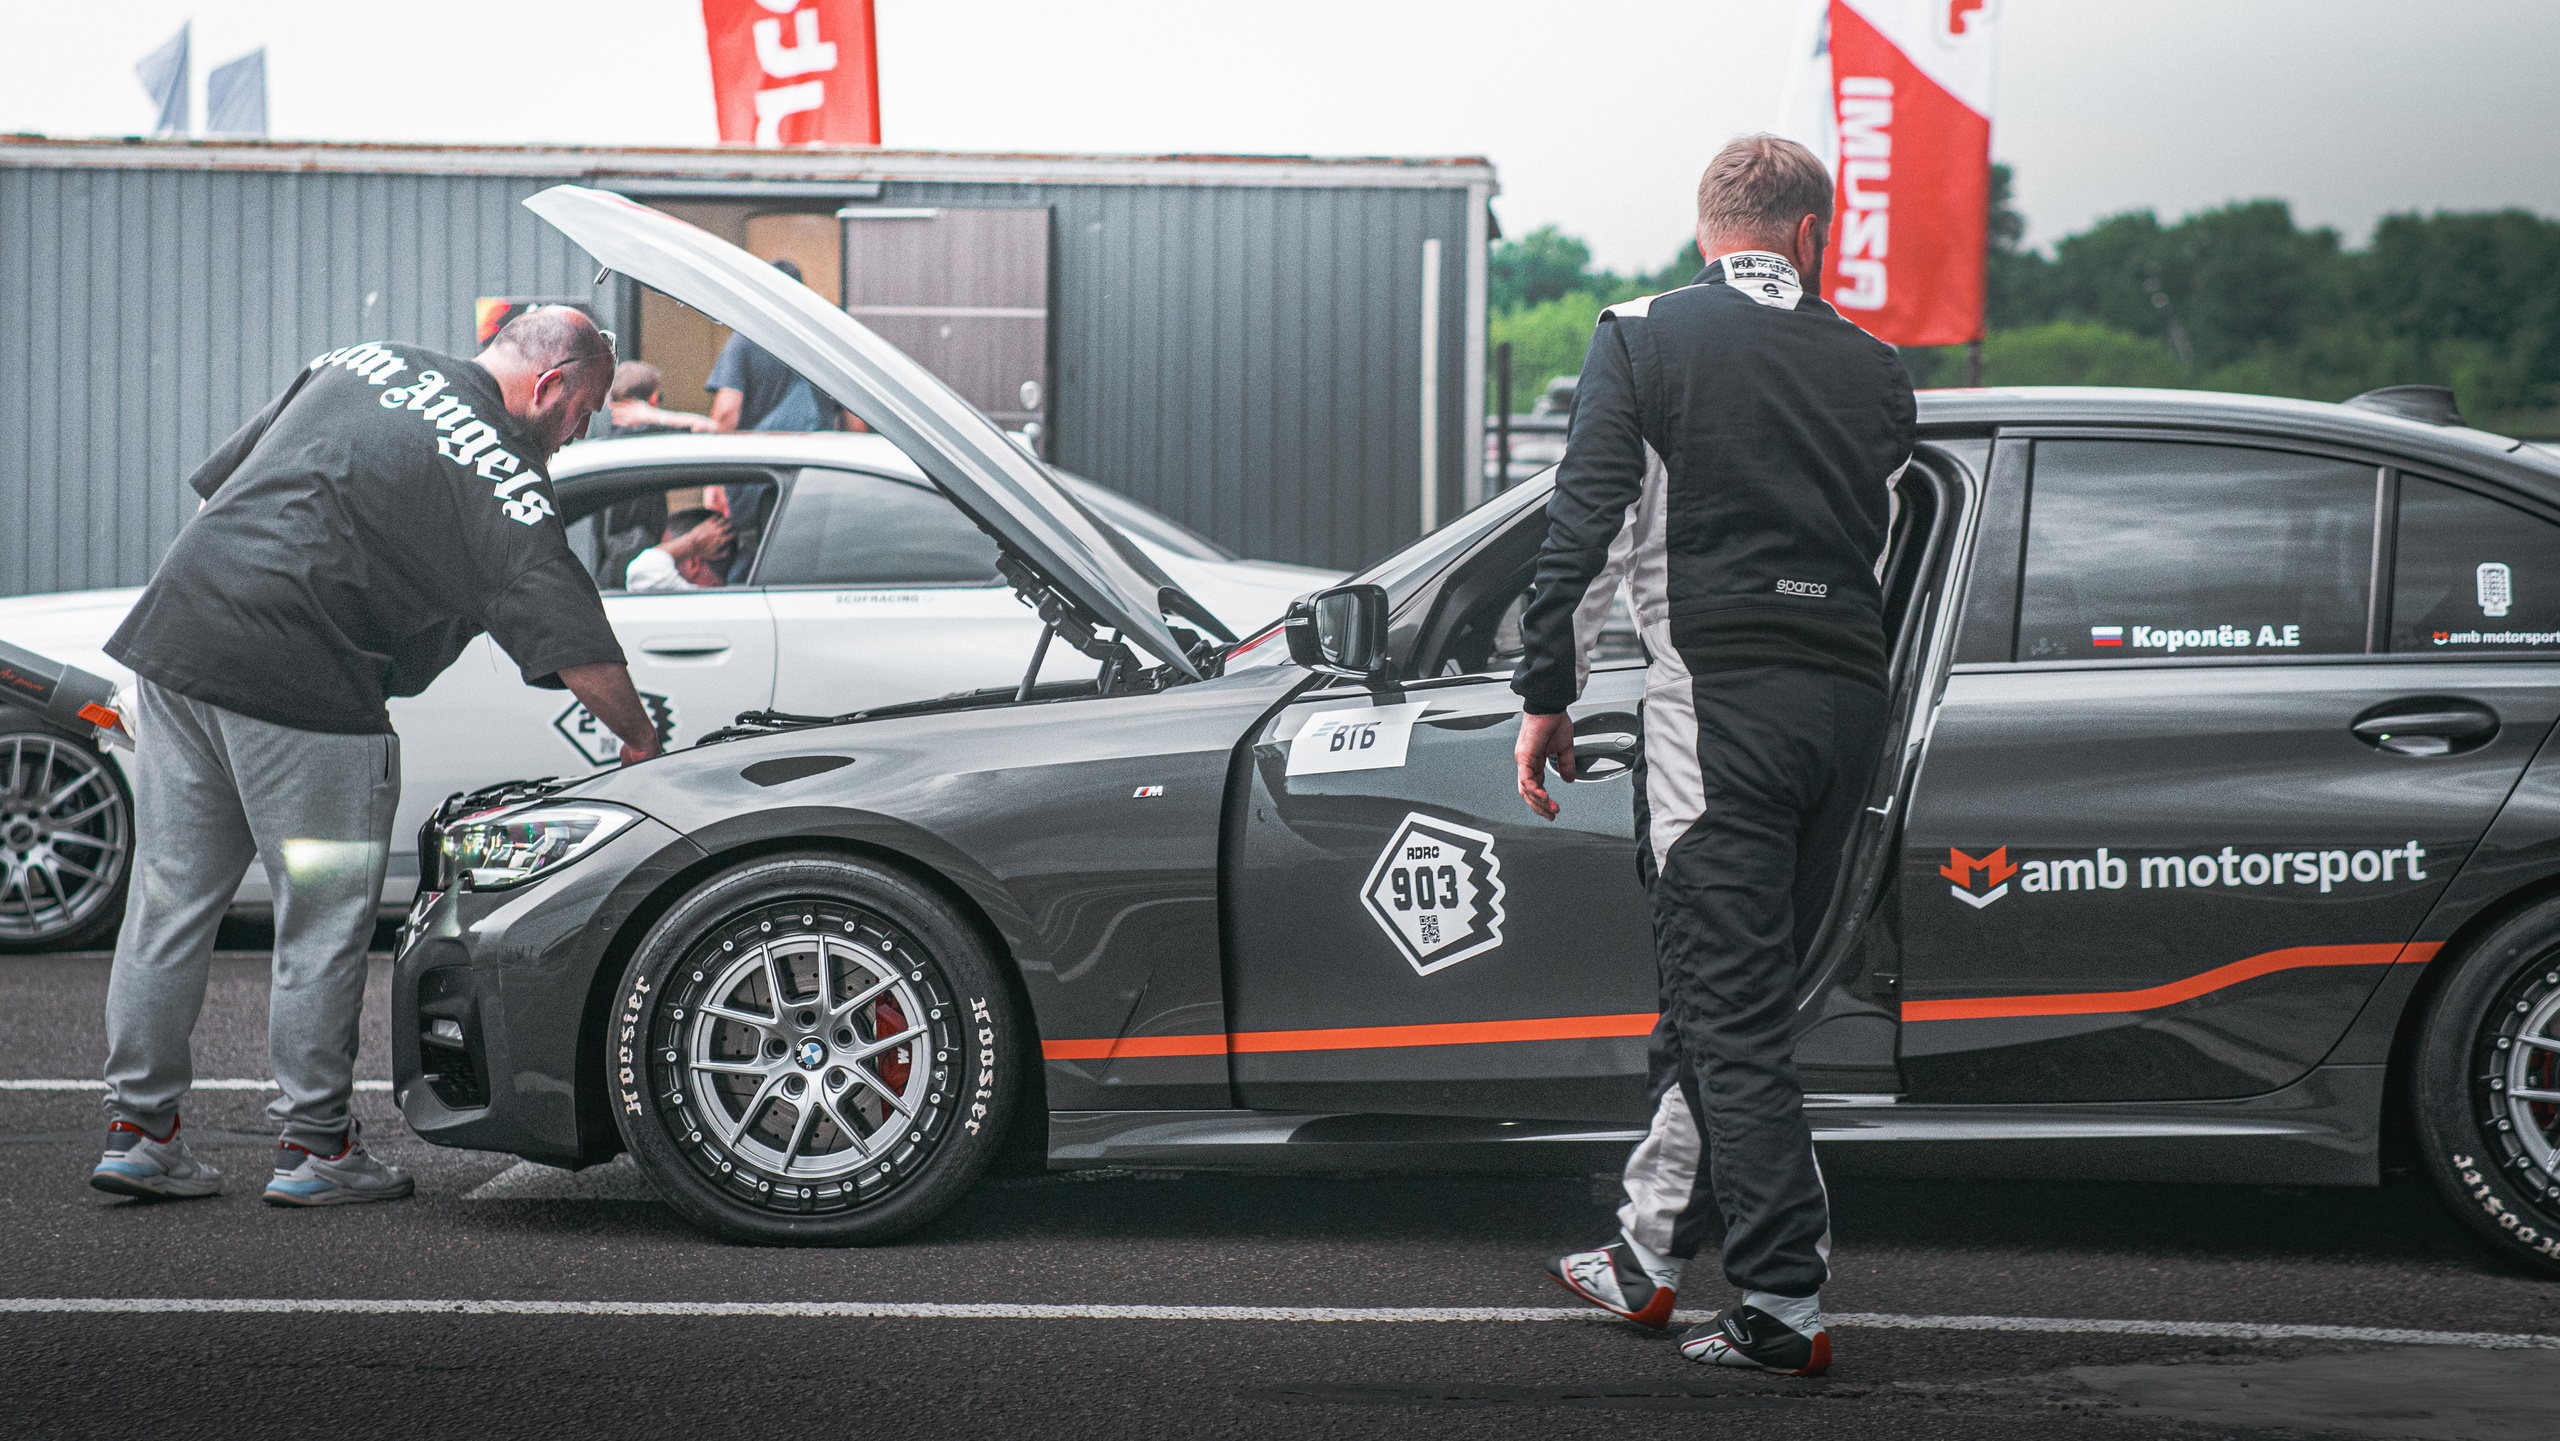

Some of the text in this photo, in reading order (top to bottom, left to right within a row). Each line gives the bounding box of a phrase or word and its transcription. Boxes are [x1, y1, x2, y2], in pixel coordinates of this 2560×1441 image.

[380, 369, 555, 526] Angels
[1776, 578, 1828, 597] sparco
[2132, 625, 2251, 653] Королёв
[2450, 630, 2560, 646] amb motorsport
[1329, 721, 1382, 752] ВТБ
[1406, 846, 1440, 860] RDRC
[2021, 840, 2428, 893] amb motorsport
[1391, 865, 1459, 911] 903
[618, 975, 650, 1116] Hoosier
[954, 997, 995, 1136] Hoosier
[2453, 1154, 2560, 1260] Hoosier
